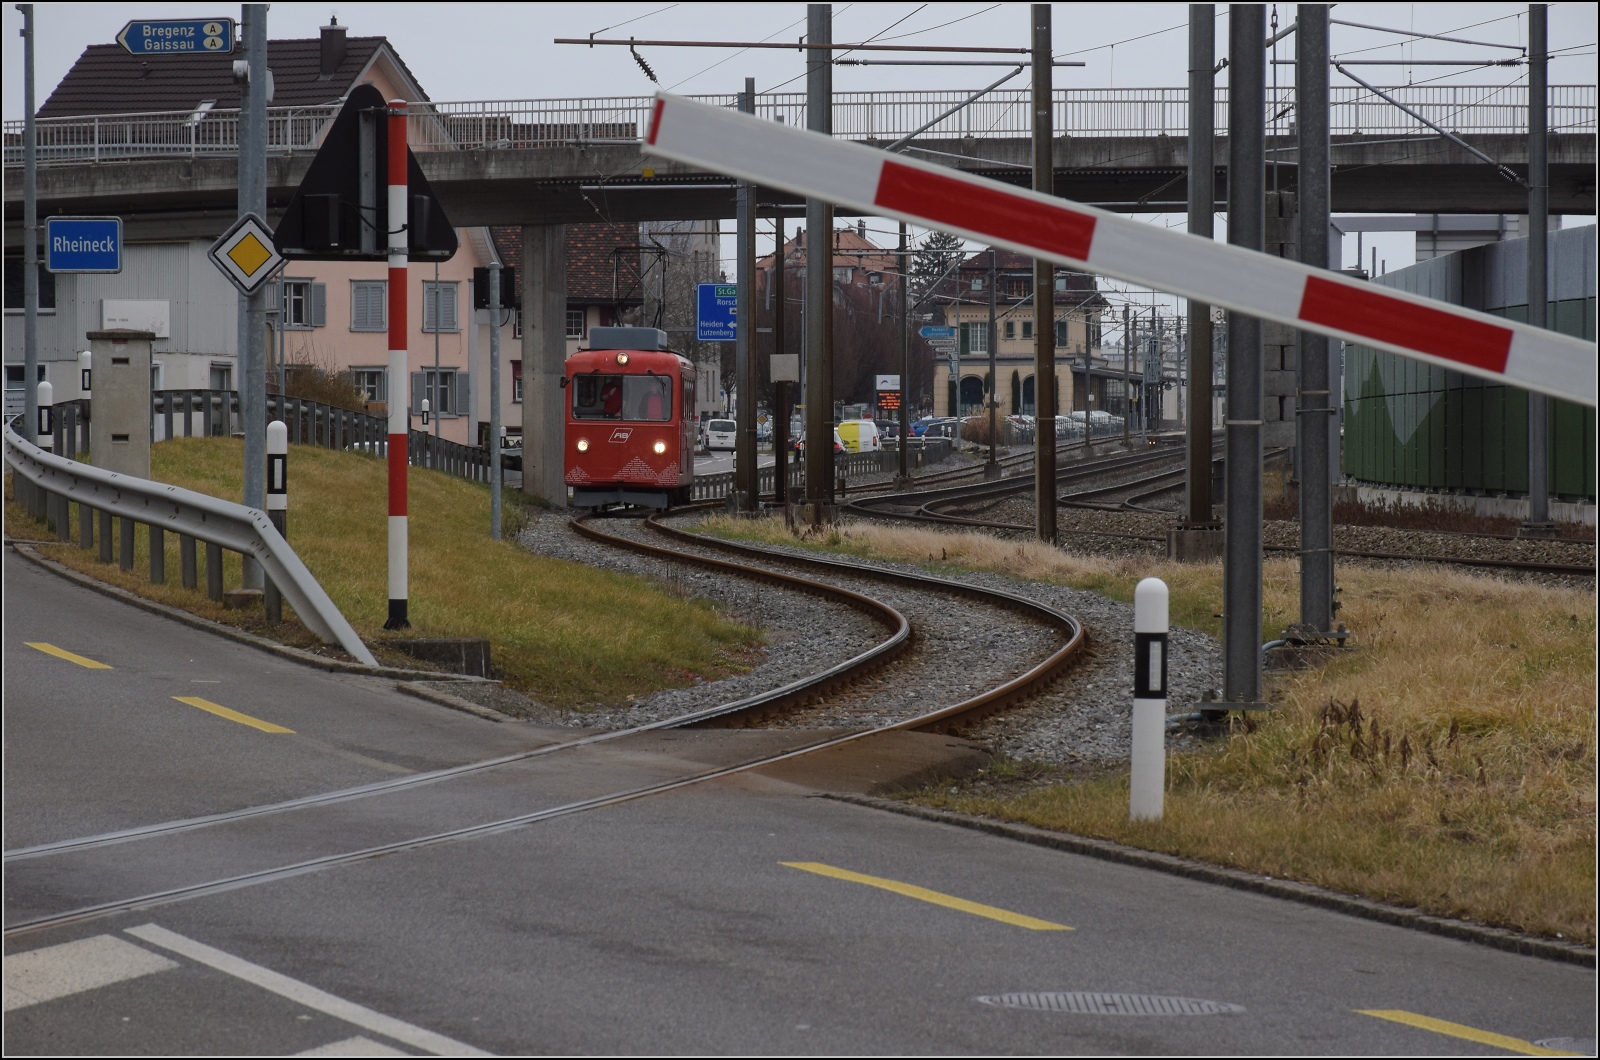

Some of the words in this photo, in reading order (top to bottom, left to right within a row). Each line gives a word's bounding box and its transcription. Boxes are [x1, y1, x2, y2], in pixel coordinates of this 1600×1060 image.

[142, 25, 195, 39] Bregenz
[209, 25, 216, 33] A
[144, 39, 195, 50] Gaissau
[209, 39, 217, 47] A
[53, 235, 115, 252] Rheineck
[718, 287, 736, 295] St.Ga
[700, 320, 724, 328] Heiden
[700, 329, 734, 338] Lutzenberg
